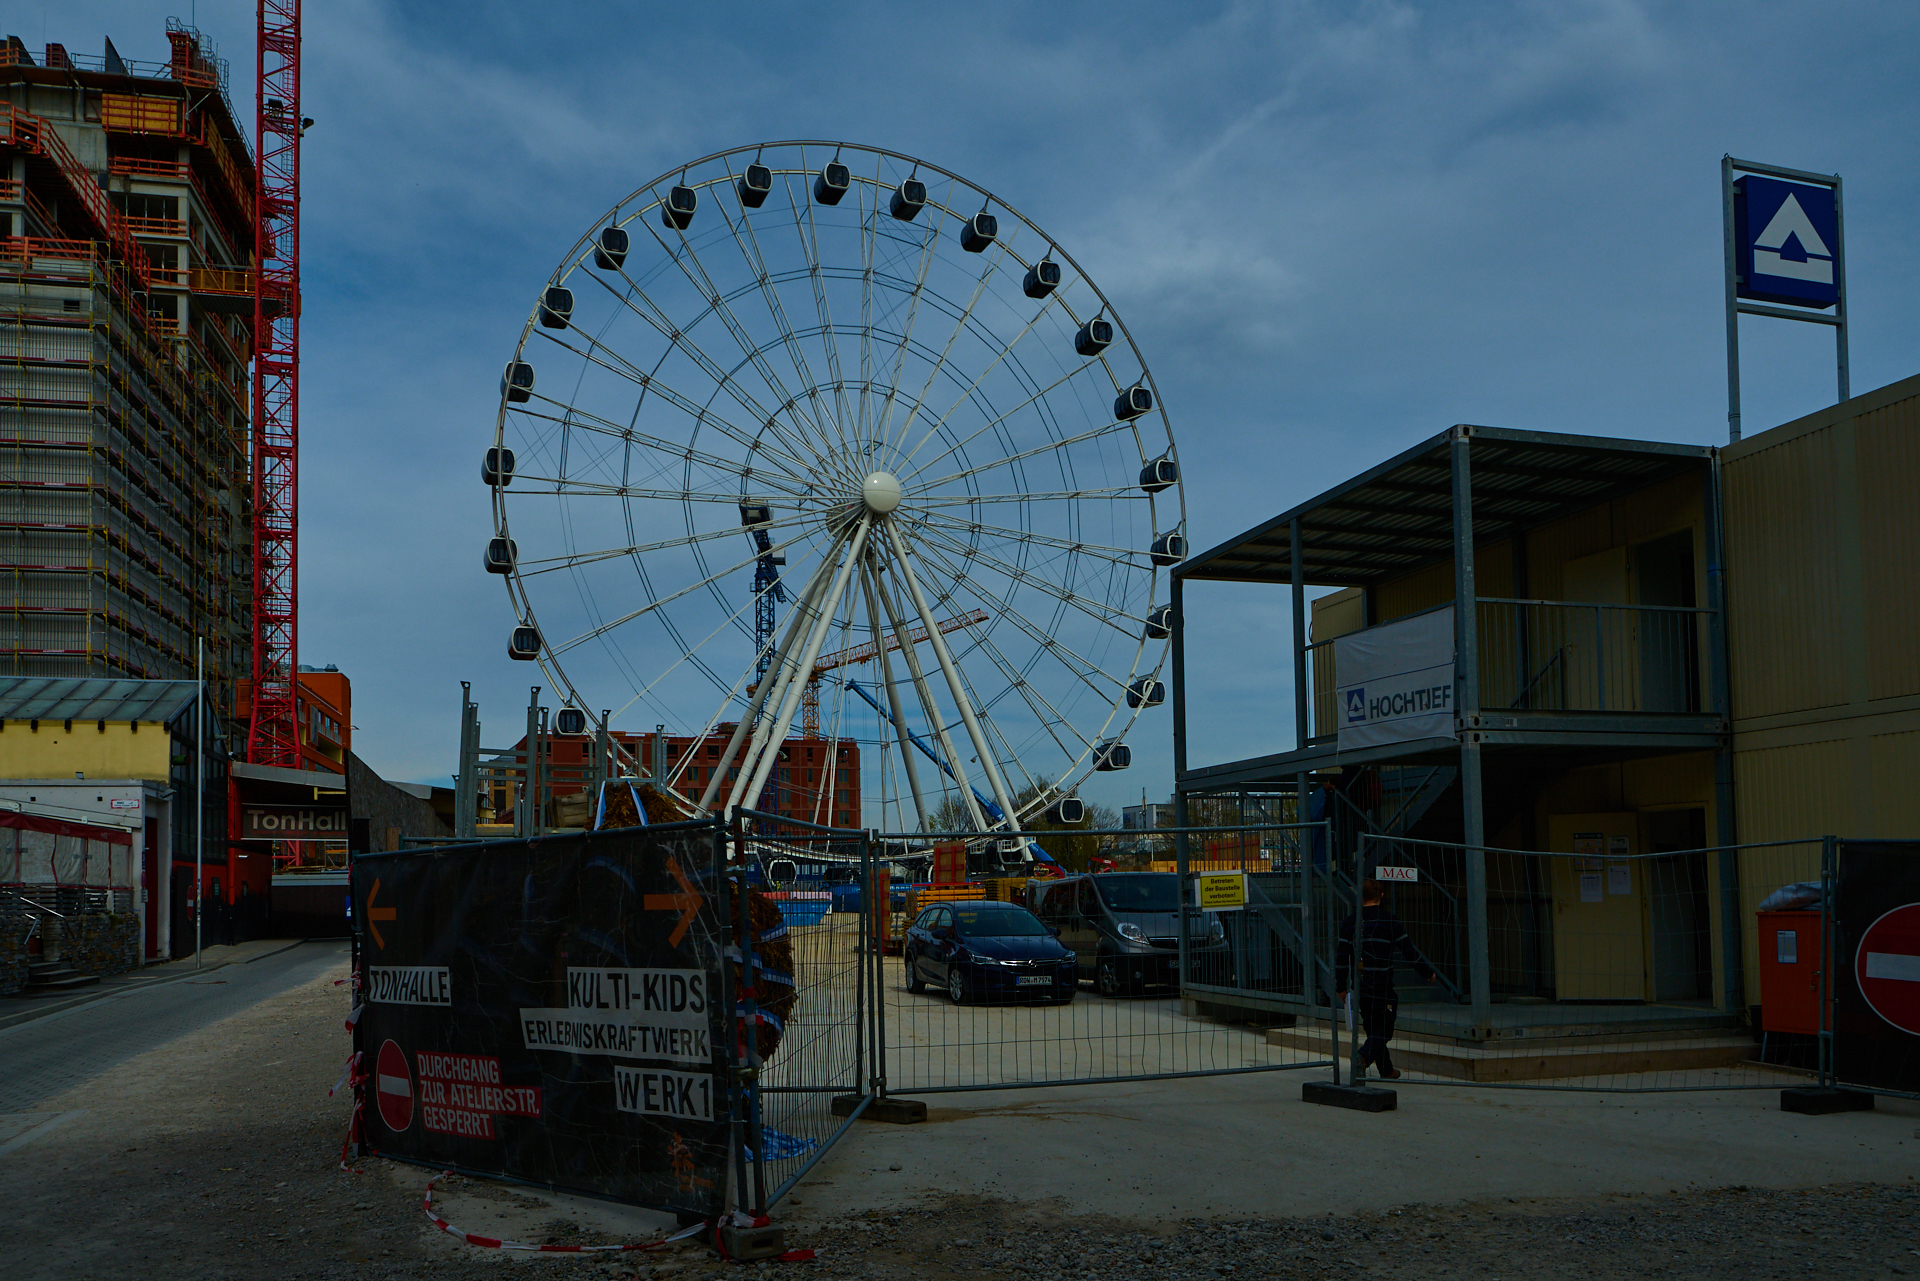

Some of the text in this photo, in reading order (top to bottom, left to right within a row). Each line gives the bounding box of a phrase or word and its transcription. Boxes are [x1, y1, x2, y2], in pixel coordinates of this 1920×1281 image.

[1370, 685, 1451, 719] HOCHTIEF
[1383, 868, 1414, 879] MAC
[371, 970, 450, 1003] TONHALLE
[569, 972, 705, 1014] KULTI-KIDS
[525, 1020, 709, 1057] ERLEBNISKRAFTWERK
[417, 1054, 500, 1084] DURCHGANG
[420, 1080, 540, 1115] ZUR ATELIERSTR.
[423, 1106, 490, 1137] GESPERRT
